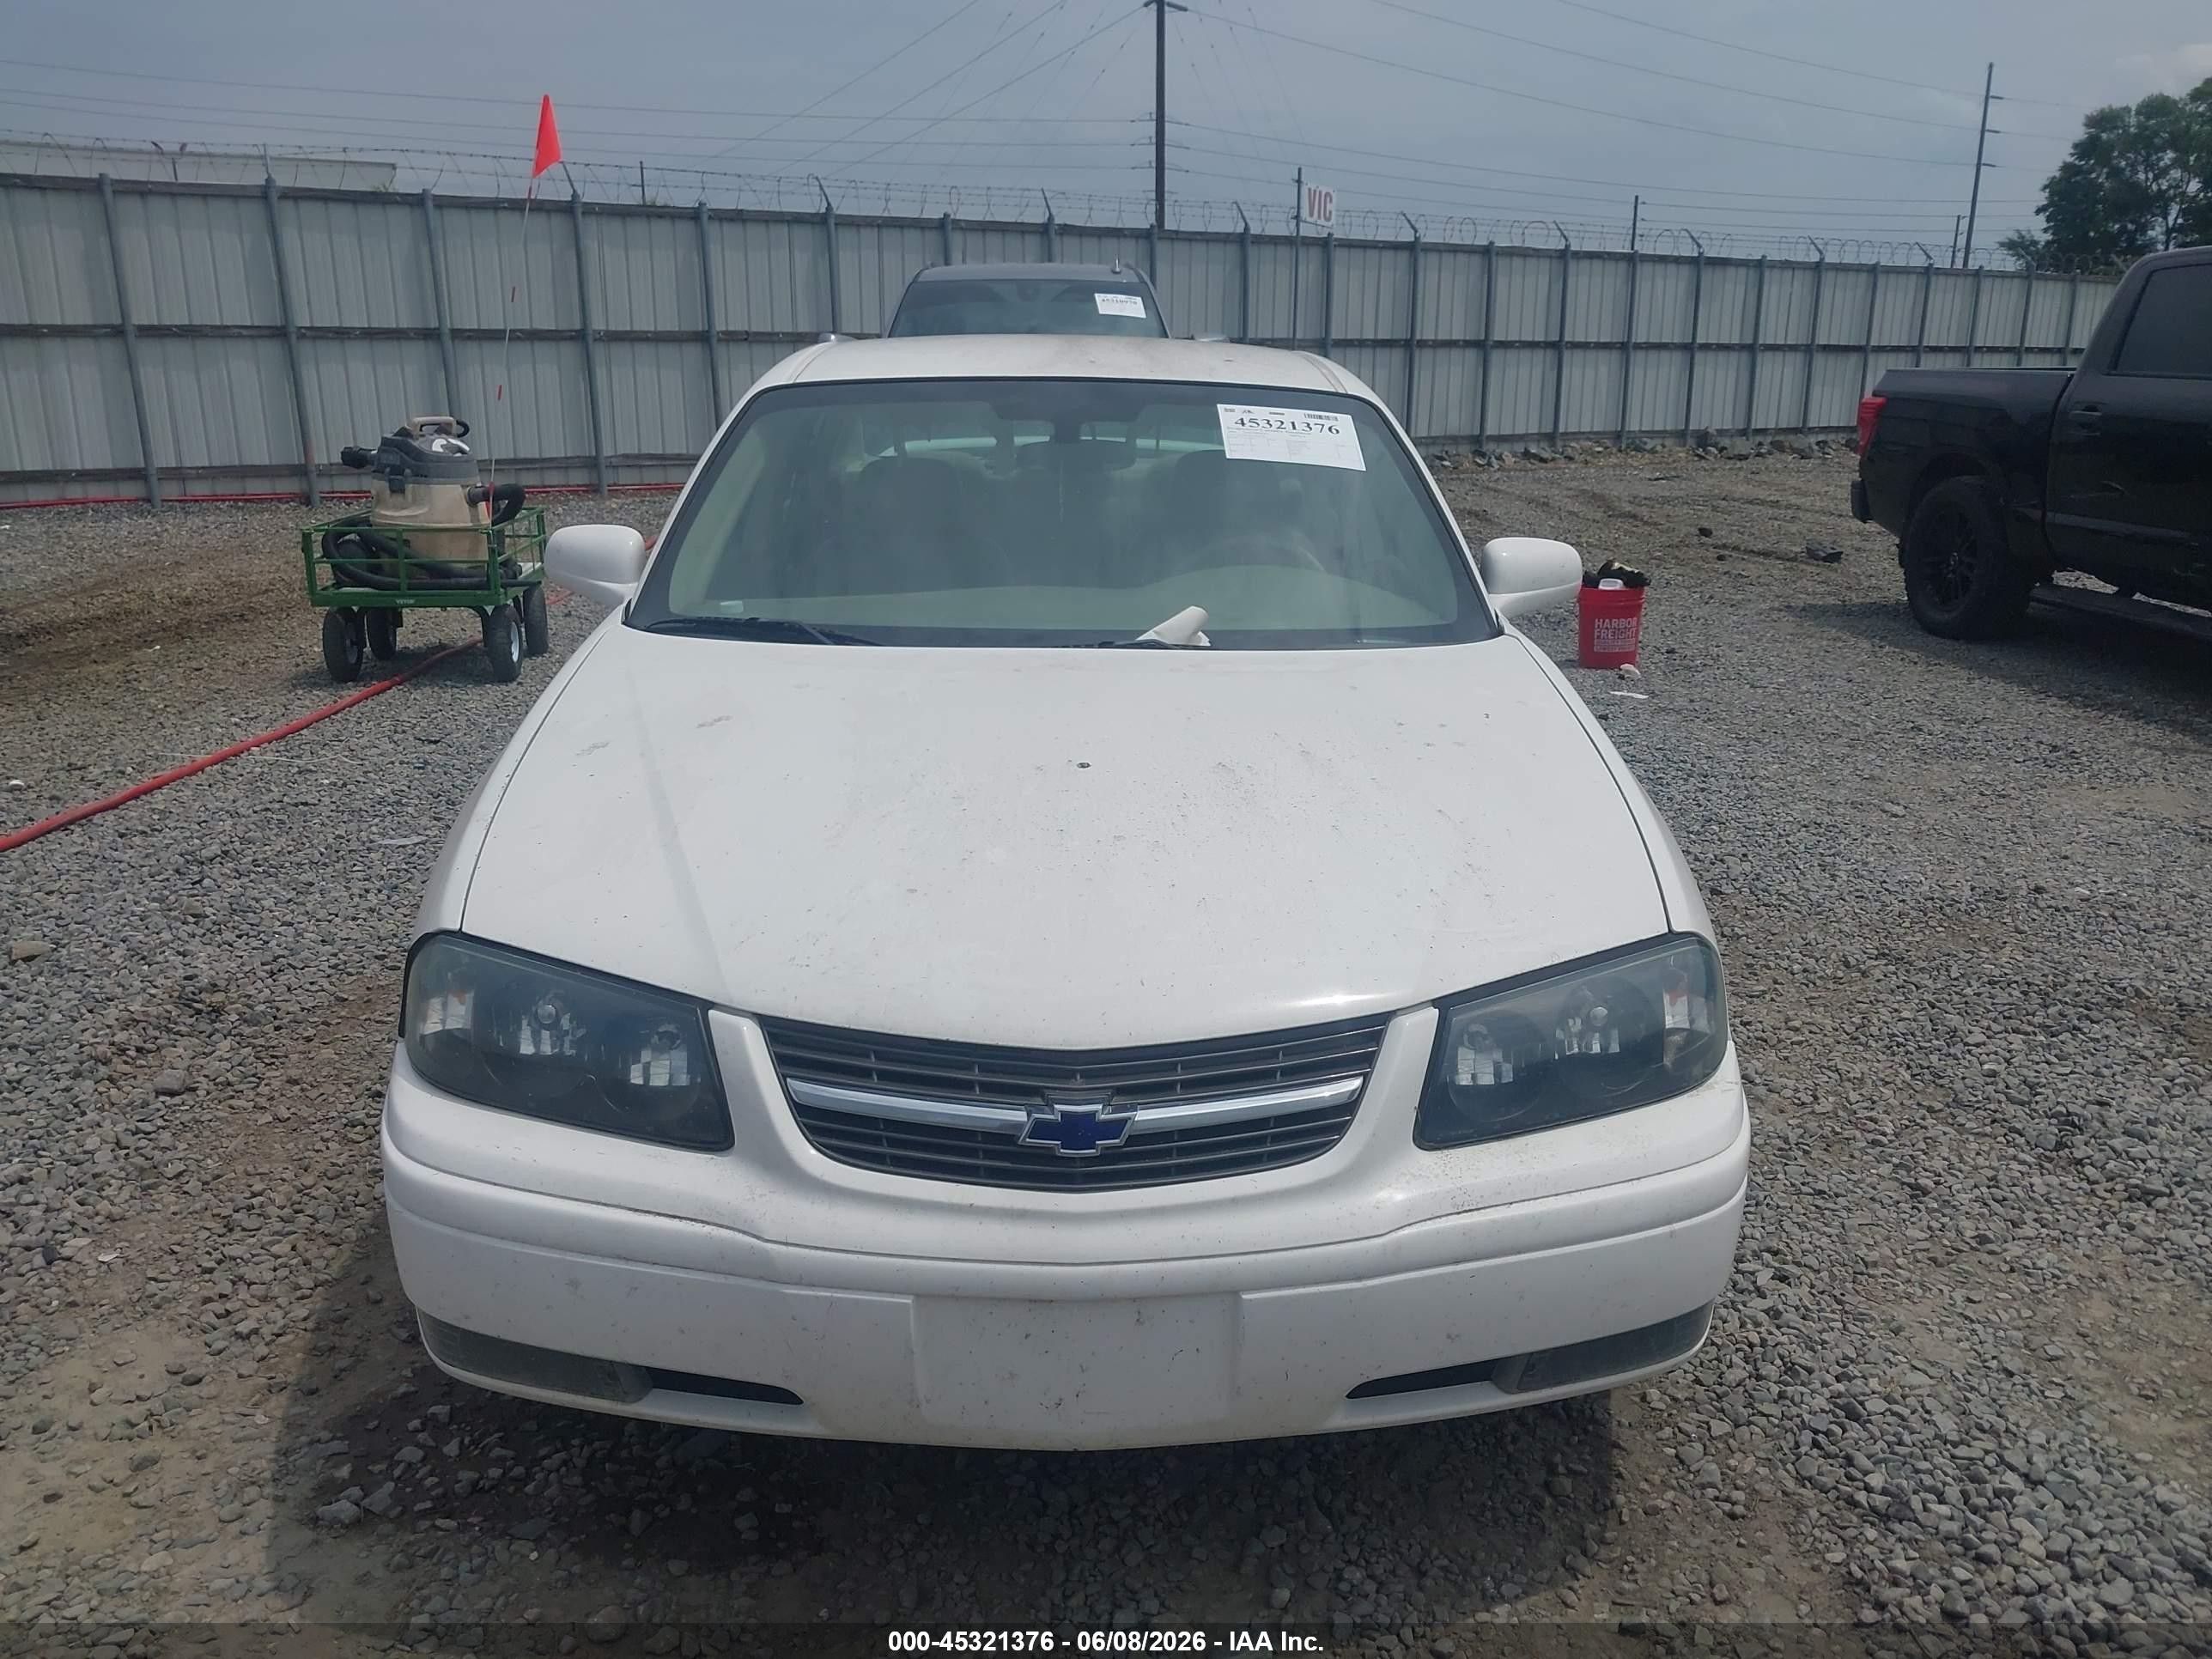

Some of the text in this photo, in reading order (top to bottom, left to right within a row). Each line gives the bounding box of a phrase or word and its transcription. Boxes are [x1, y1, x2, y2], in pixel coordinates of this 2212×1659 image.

[1308, 187, 1333, 222] VIC
[1234, 416, 1340, 435] 45321376
[1595, 617, 1637, 629] HARBOR
[1594, 628, 1637, 639] FREIGHT
